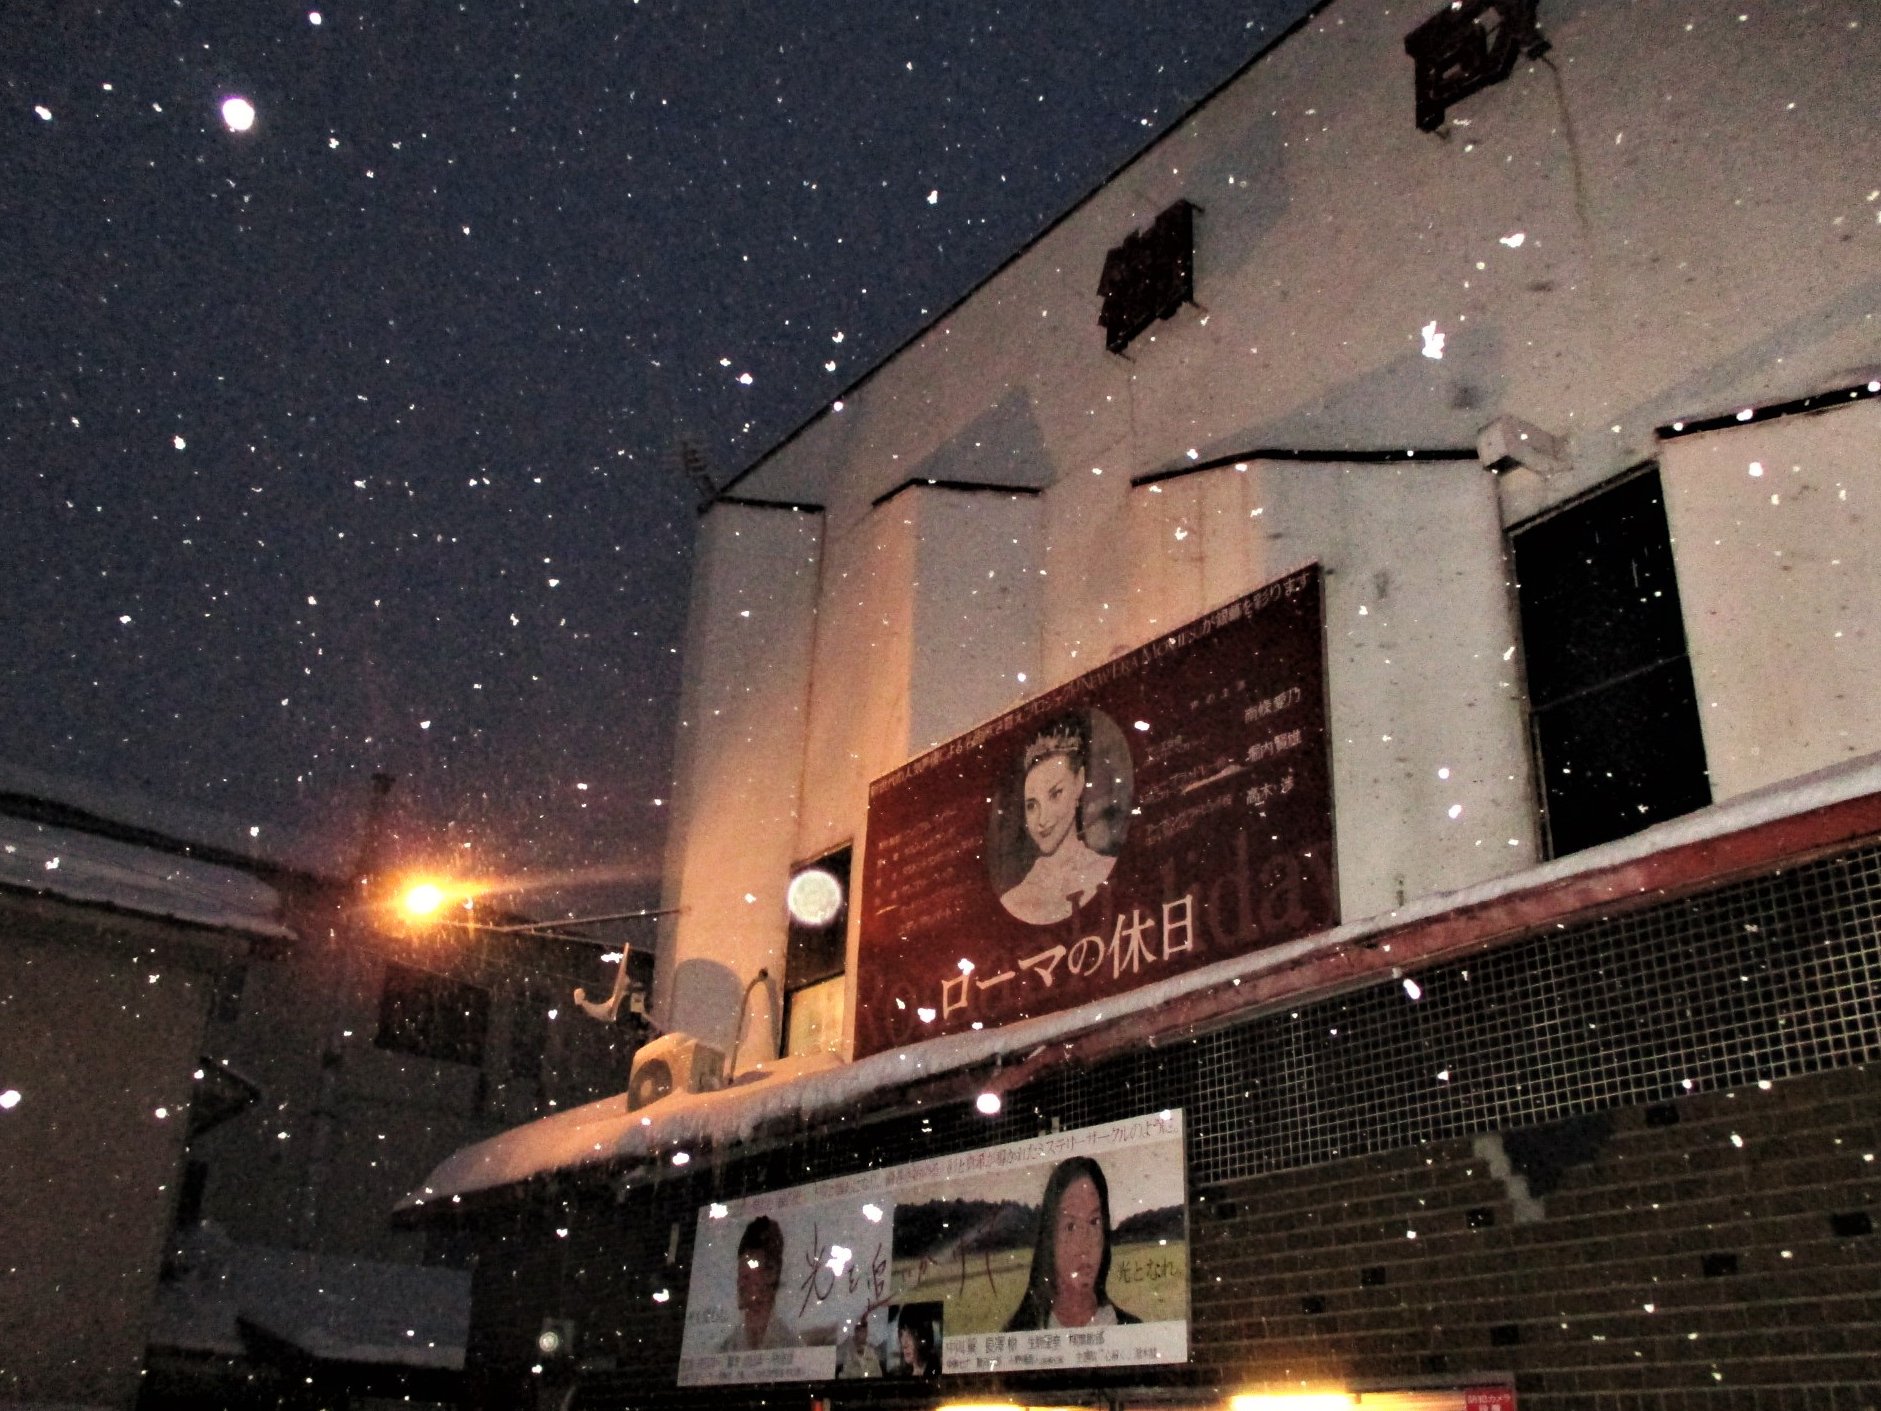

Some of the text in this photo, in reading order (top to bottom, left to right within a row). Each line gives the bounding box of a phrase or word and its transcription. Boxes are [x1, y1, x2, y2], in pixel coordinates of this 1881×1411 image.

[942, 894, 1196, 1019] ローマの休日
